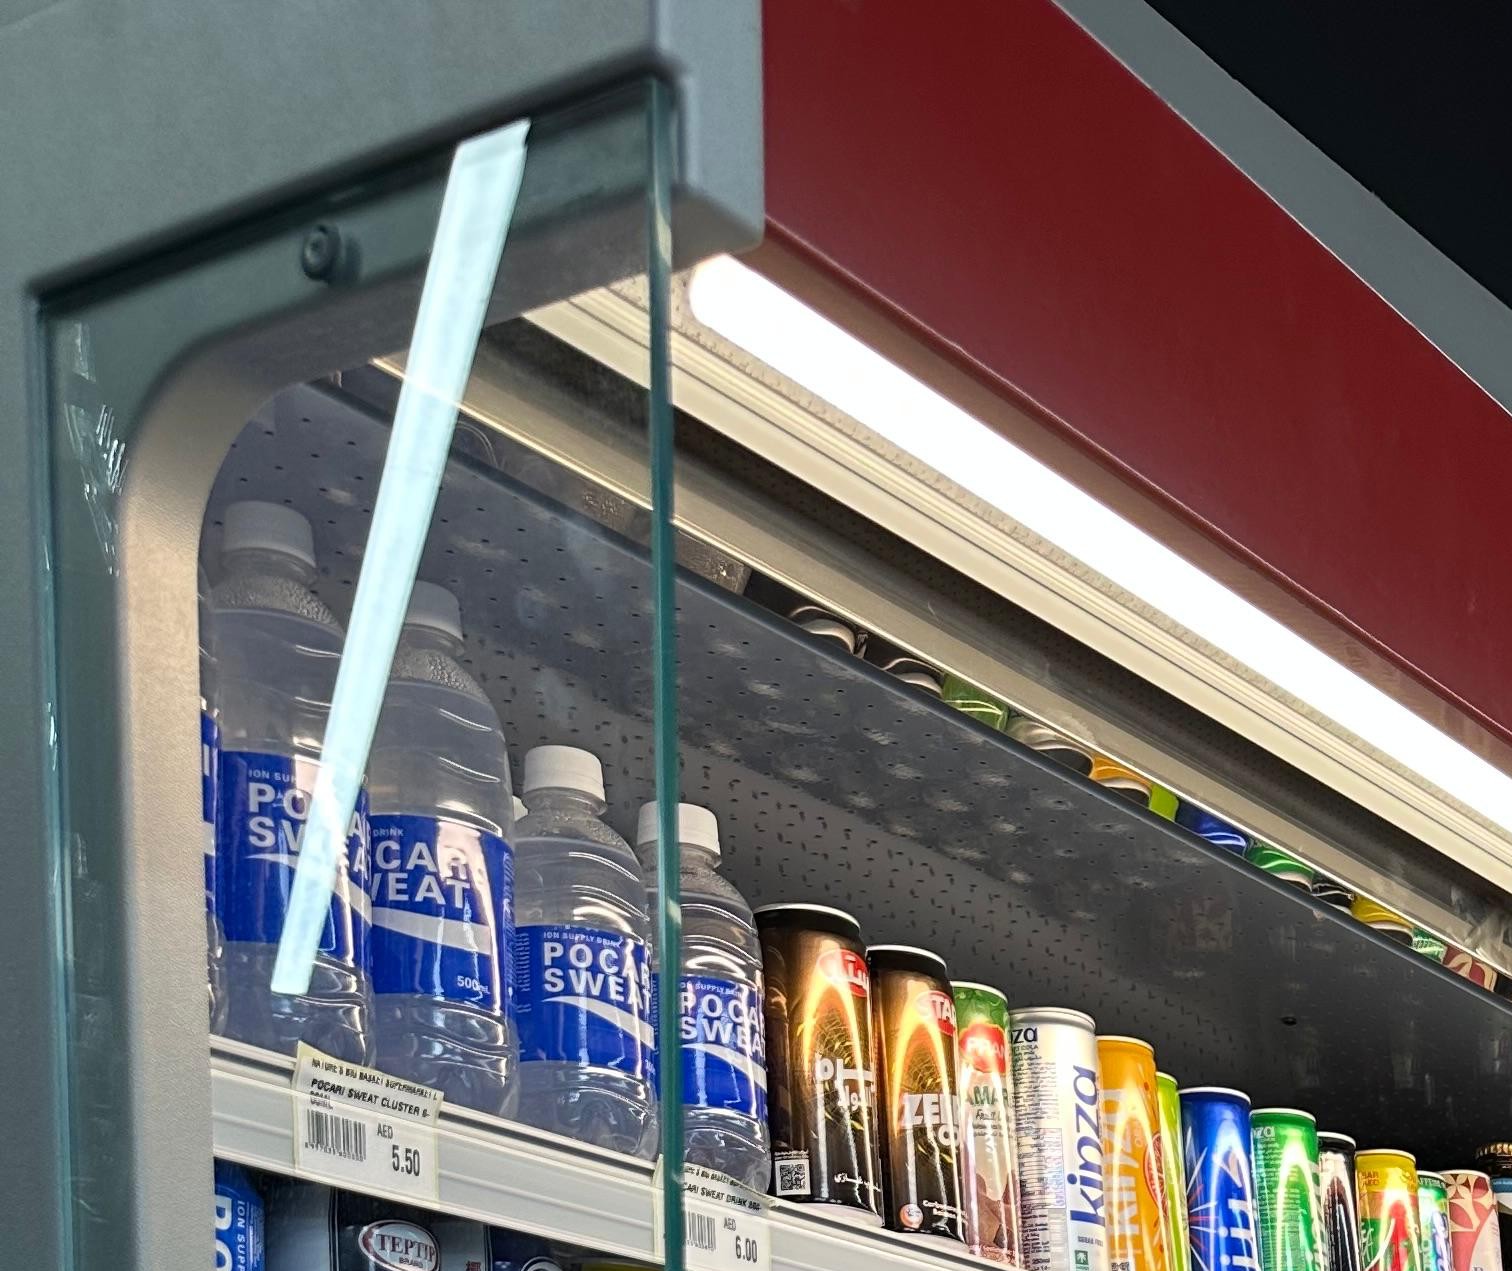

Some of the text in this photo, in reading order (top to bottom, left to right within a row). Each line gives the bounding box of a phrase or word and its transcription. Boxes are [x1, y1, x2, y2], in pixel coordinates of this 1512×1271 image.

[347, 1088, 380, 1105] SWEAT
[377, 1122, 393, 1139] AED
[392, 1145, 420, 1177] 5.50
[237, 1200, 246, 1227] ION
[735, 1235, 758, 1263] 6.00
